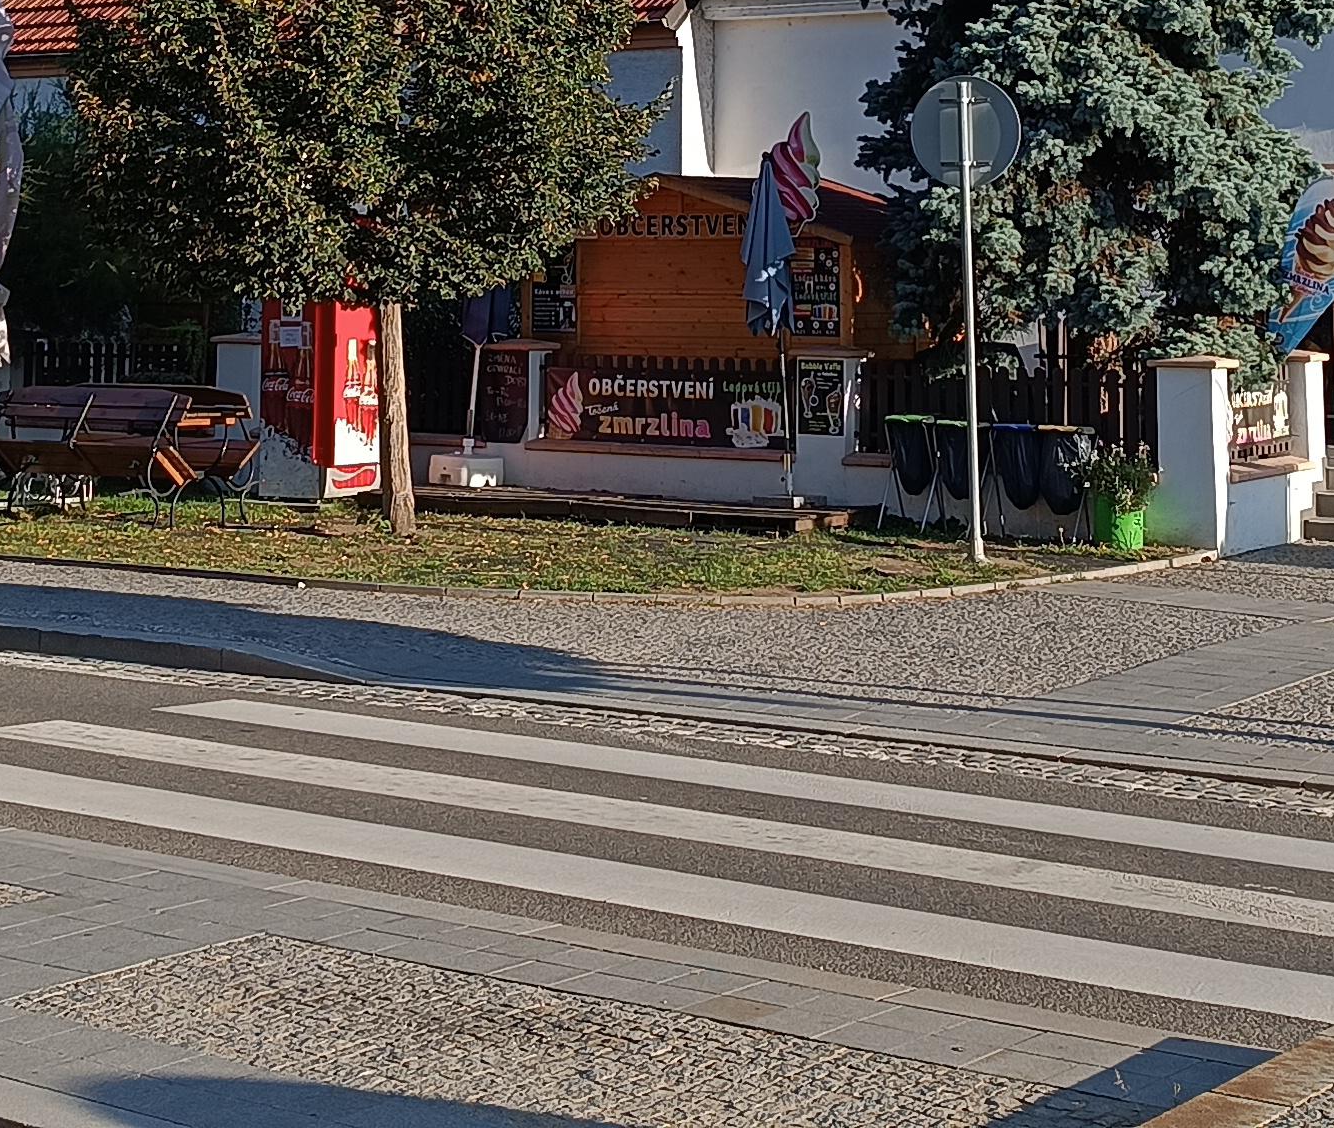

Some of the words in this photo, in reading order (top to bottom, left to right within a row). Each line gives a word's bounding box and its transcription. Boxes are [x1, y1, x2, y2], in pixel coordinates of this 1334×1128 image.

[286, 386, 315, 403] Coca-Col
[588, 374, 715, 400] OBČERSTVENÍ
[598, 410, 711, 439] zmrzlina
